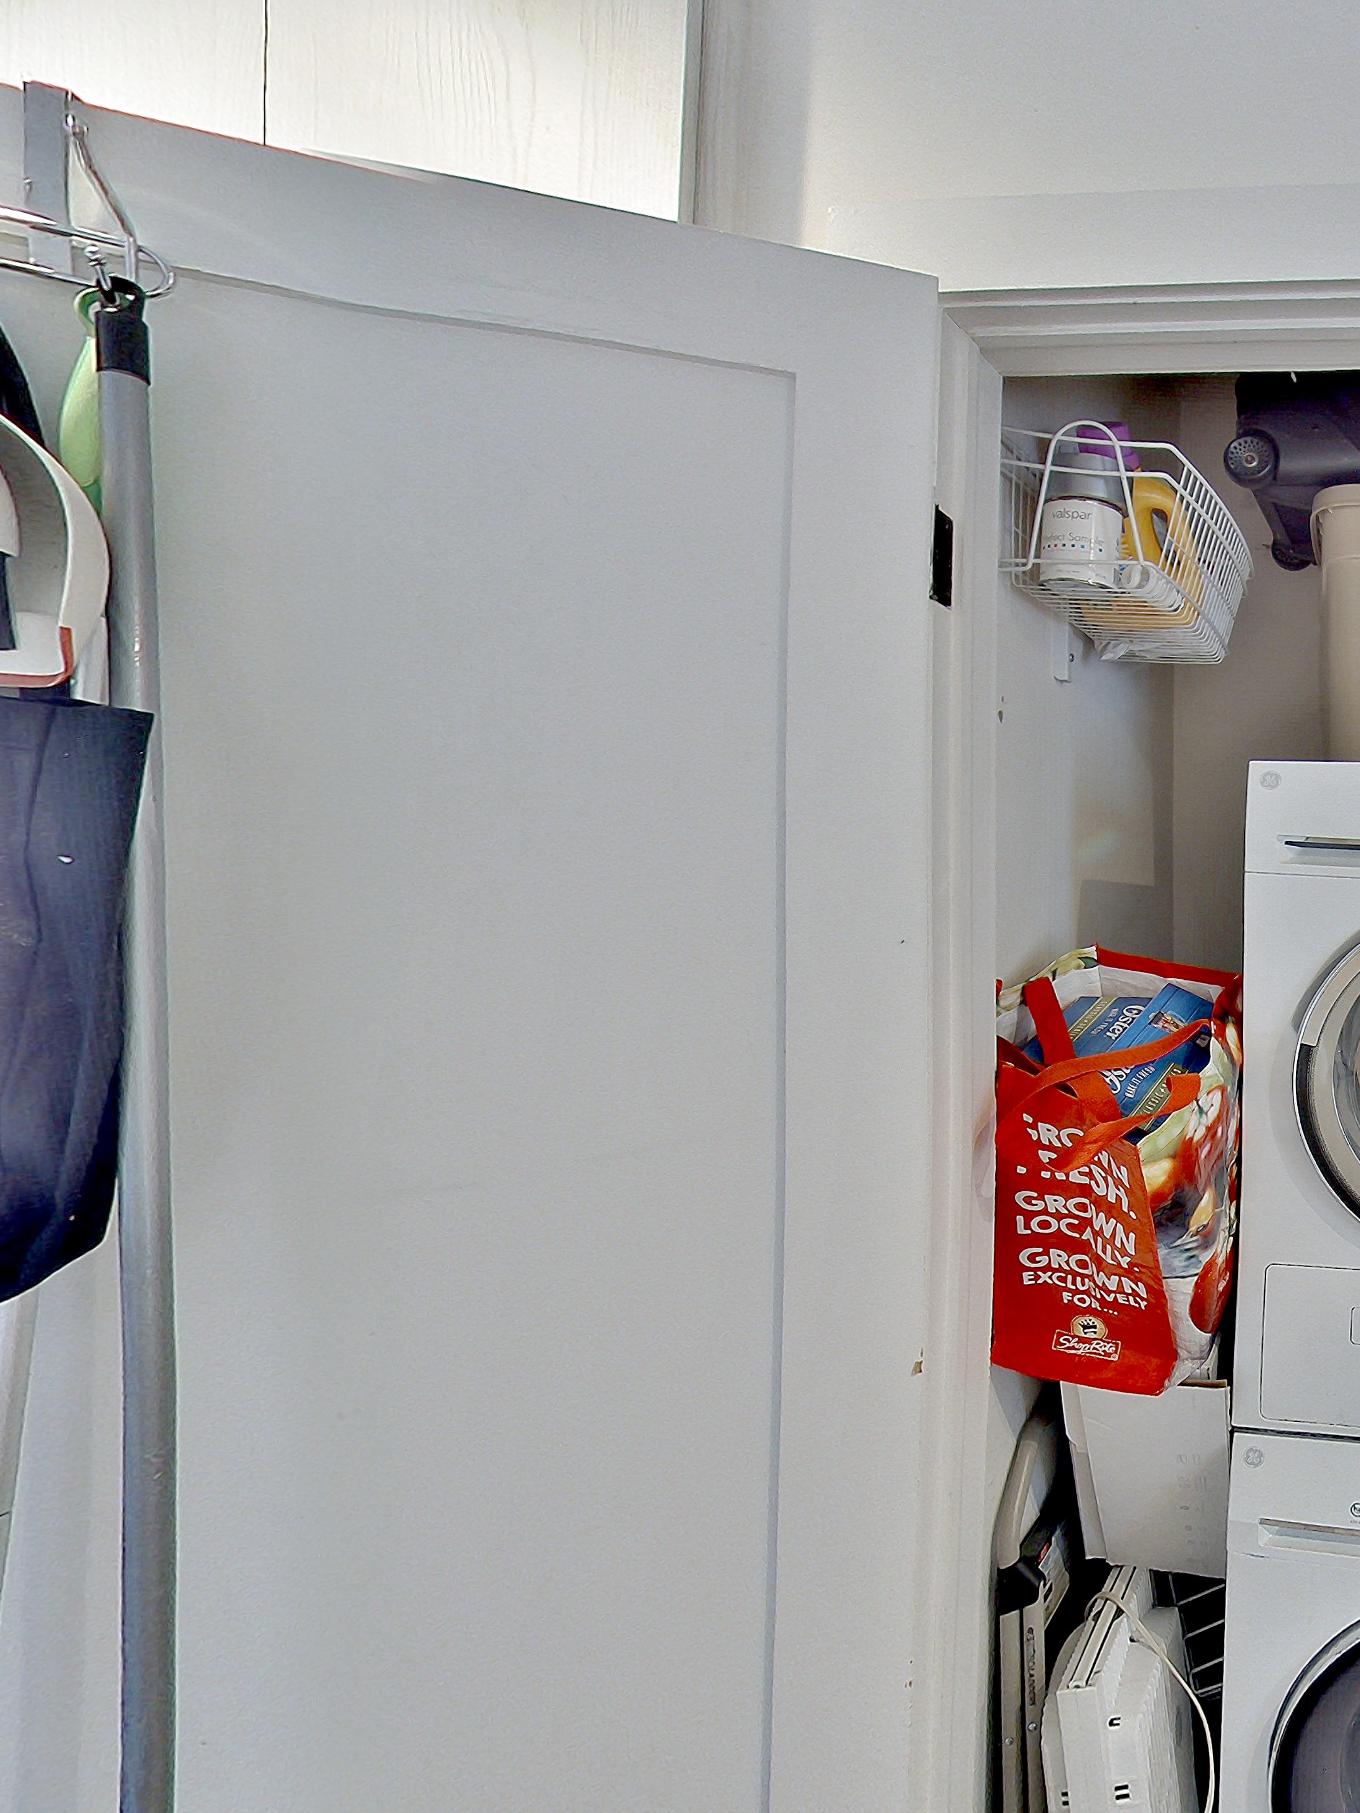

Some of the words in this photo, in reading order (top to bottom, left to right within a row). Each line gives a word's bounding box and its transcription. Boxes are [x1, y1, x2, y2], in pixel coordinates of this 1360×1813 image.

[1105, 1005, 1146, 1041] Oster
[1014, 1190, 1136, 1256] GROWN
[1016, 1215, 1140, 1272] LOCALLY.
[1018, 1247, 1148, 1299] GROWN
[1022, 1271, 1148, 1311] EXCLUSIVELY
[1058, 1335, 1117, 1356] ShopRite
